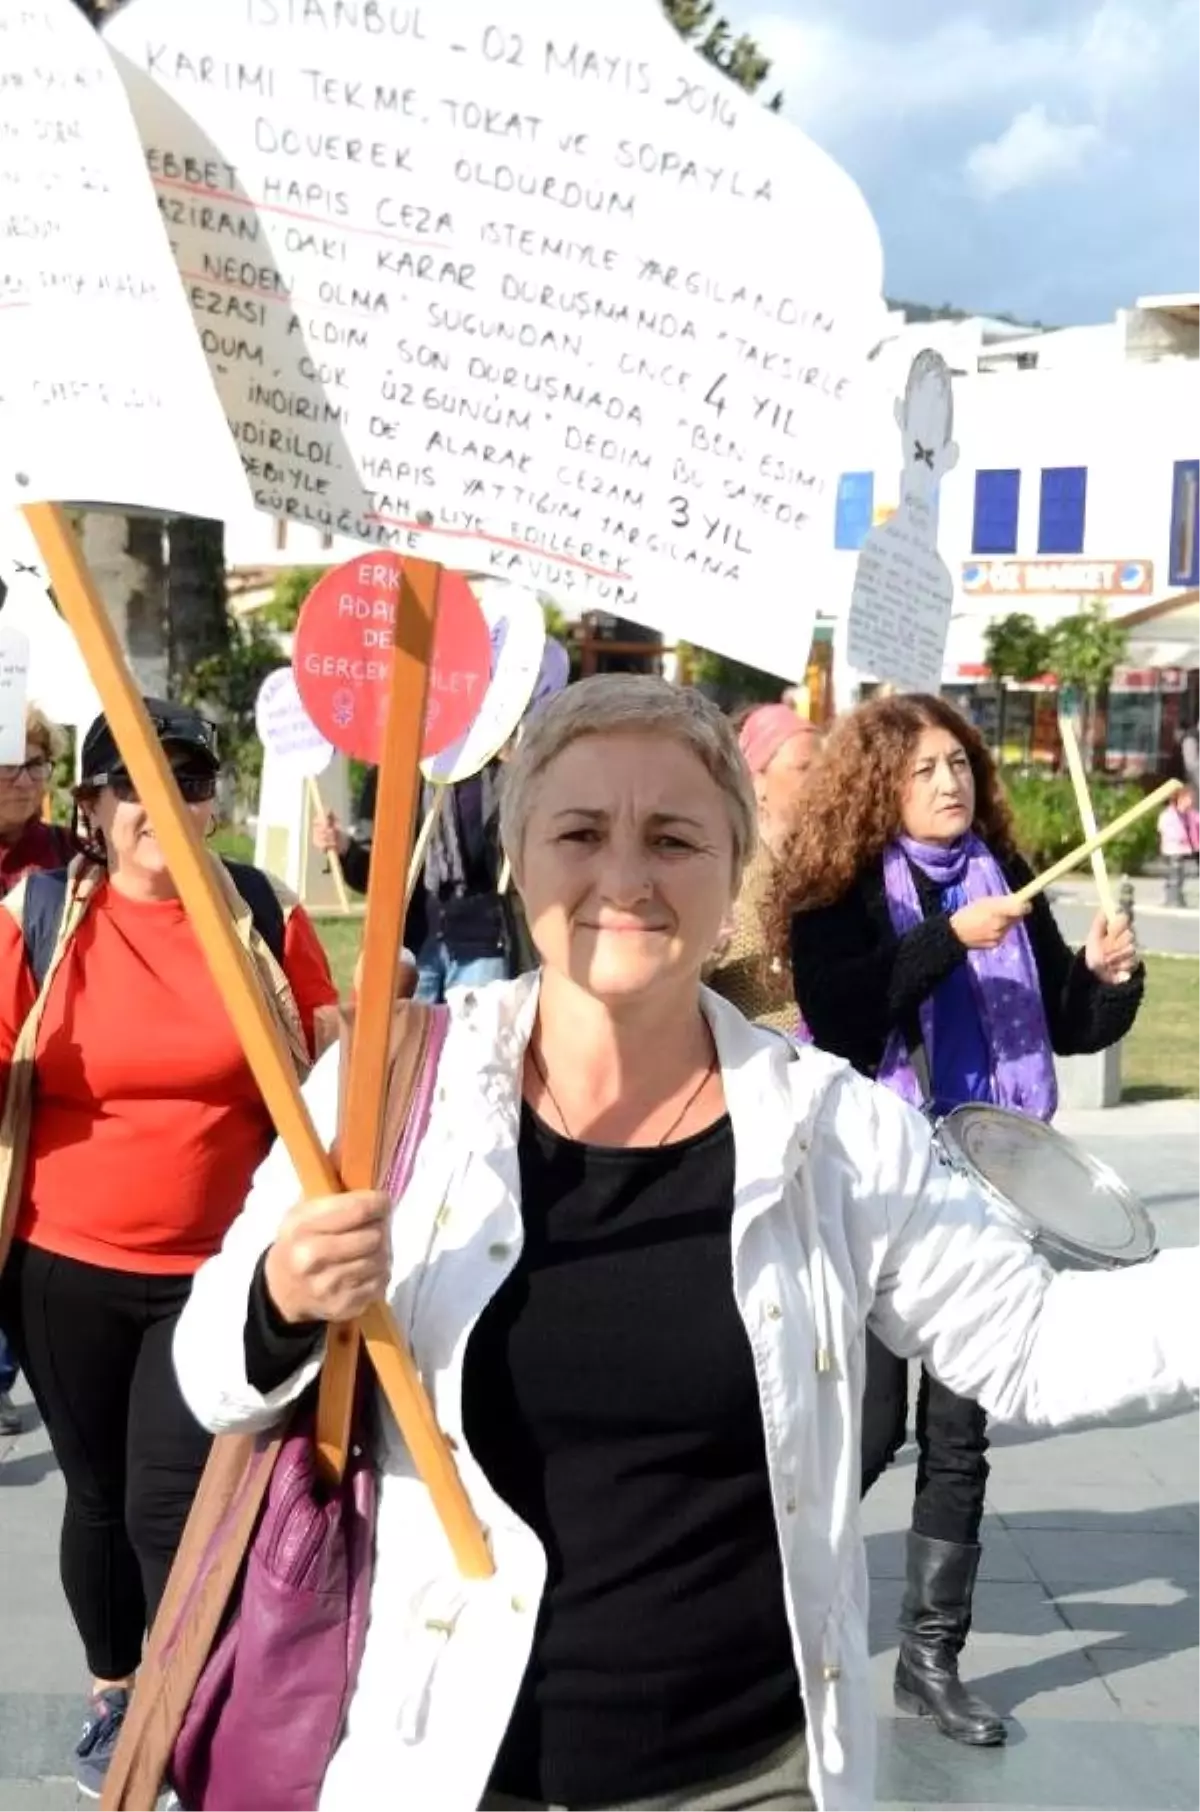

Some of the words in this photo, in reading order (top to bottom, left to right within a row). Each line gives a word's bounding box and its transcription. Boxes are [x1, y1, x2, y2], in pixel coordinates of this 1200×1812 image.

[482, 24, 524, 67] 02
[544, 38, 651, 94] MAYIS
[438, 99, 544, 142] TOKAT
[614, 138, 773, 202] SOPAYLA
[376, 197, 454, 234] CEZA
[376, 249, 477, 292] KARAR
[203, 252, 295, 295] NEDEN
[703, 371, 729, 420] 4
[752, 394, 797, 438] YIL
[286, 314, 368, 349] ALDIM
[397, 338, 449, 372] SON
[425, 430, 534, 474] ALARAK
[556, 465, 644, 510] CEZAM
[668, 494, 690, 529] 3
[702, 513, 752, 555] YIL
